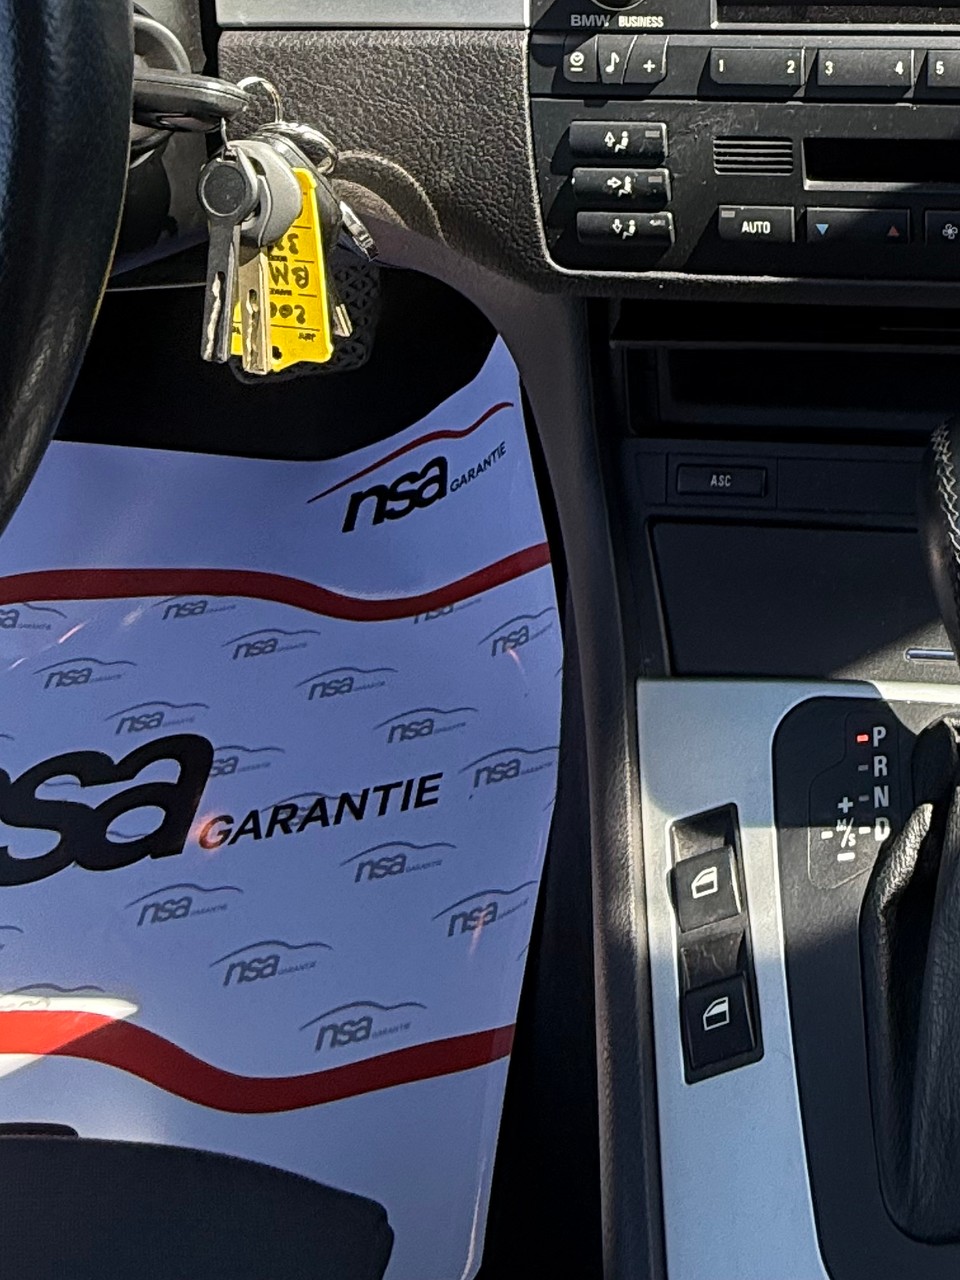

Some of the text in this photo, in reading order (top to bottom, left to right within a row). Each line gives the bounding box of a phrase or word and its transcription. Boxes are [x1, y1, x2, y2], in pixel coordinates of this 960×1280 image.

[570, 14, 664, 28] BMW BUSINESS
[718, 59, 724, 73] 1
[786, 60, 795, 74] 2
[825, 60, 834, 75] 3
[895, 60, 904, 75] 4
[935, 62, 944, 76] 5
[741, 220, 771, 235] AUTO
[342, 441, 507, 533] nsa GARANTIE
[710, 473, 732, 488] ASC
[162, 600, 208, 621] nsa
[232, 638, 279, 660] nsa
[44, 667, 93, 690] nsa
[308, 676, 354, 700] nsa
[115, 711, 164, 735] nsa
[387, 718, 435, 744] nsa
[872, 726, 887, 747] P
[473, 758, 522, 788] nsa
[873, 755, 888, 777] R
[873, 785, 889, 808] N
[198, 772, 444, 850] GARANTIE
[874, 817, 891, 841] D
[354, 853, 407, 884] nsa
[137, 895, 193, 927] nsa
[448, 901, 499, 937] nsa
[223, 954, 281, 987] nsa
[314, 1015, 374, 1053] nsa
